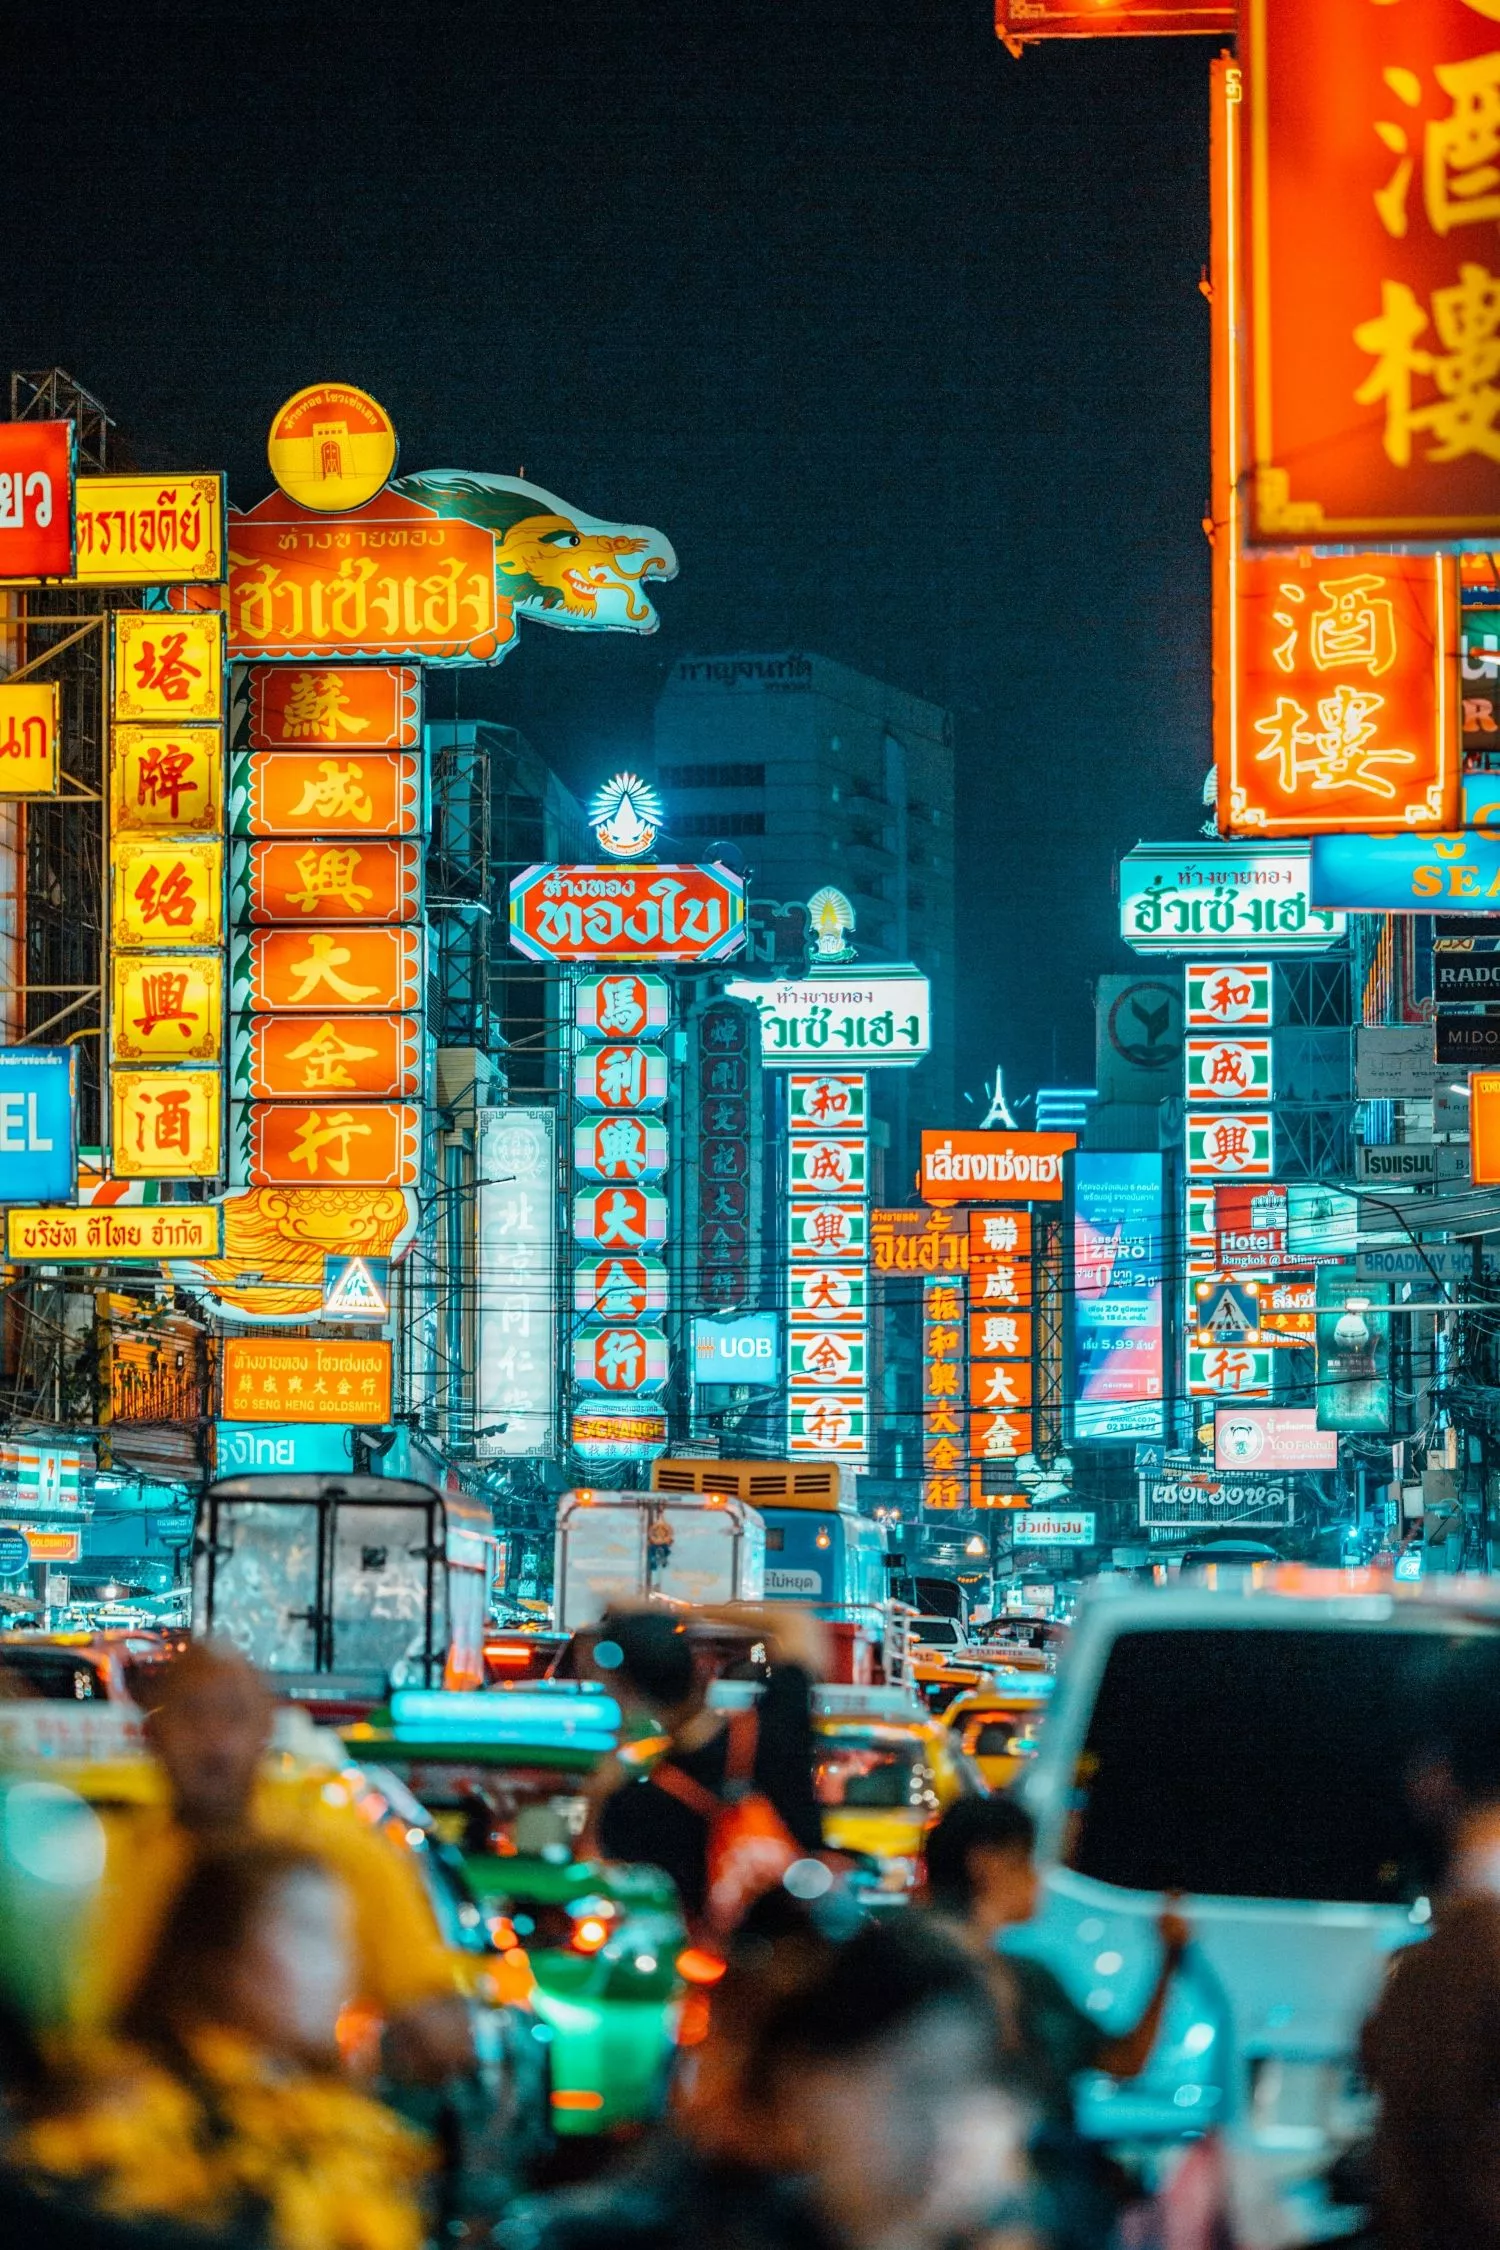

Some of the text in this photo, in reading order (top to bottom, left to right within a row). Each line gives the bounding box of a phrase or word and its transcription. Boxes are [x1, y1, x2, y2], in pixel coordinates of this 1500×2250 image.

[77, 489, 202, 555] ตราเจดีย์
[278, 527, 446, 550] ห้างขายทอง
[1255, 573, 1416, 799] 酒樓
[542, 871, 635, 898] ห้างทอง
[1178, 867, 1292, 885] ห้างขายทอง
[536, 877, 721, 945] ทองใบ
[283, 672, 382, 1176] 蘇成興大金行
[777, 986, 873, 1004] ห้างขายทอง
[756, 995, 920, 1048] ั่วเซ่งเฮง
[1448, 1031, 1498, 1044] MIDO
[1206, 976, 1252, 1390] 和成興行
[24, 1216, 203, 1248] บริษัท ดีไทย จำกัด
[1091, 1236, 1145, 1244] ABSOLUTE
[1220, 1232, 1274, 1250] Hotel
[806, 1076, 848, 1444] 和成興大金行
[1090, 1245, 1146, 1259] ZERO
[1221, 1255, 1266, 1267] Bangkok
[1283, 1254, 1338, 1265] Chinatown
[1365, 1253, 1496, 1273] BROADWAY HOEL
[720, 1338, 772, 1359] UOB
[1101, 1339, 1134, 1350] 5.99
[234, 1351, 308, 1371] ห้างขายทอง
[982, 1216, 1019, 1506] 聯成興大金
[233, 1398, 381, 1412] SO SENG HENG GOLDSMITH
[572, 1419, 664, 1439] EXCHANGE
